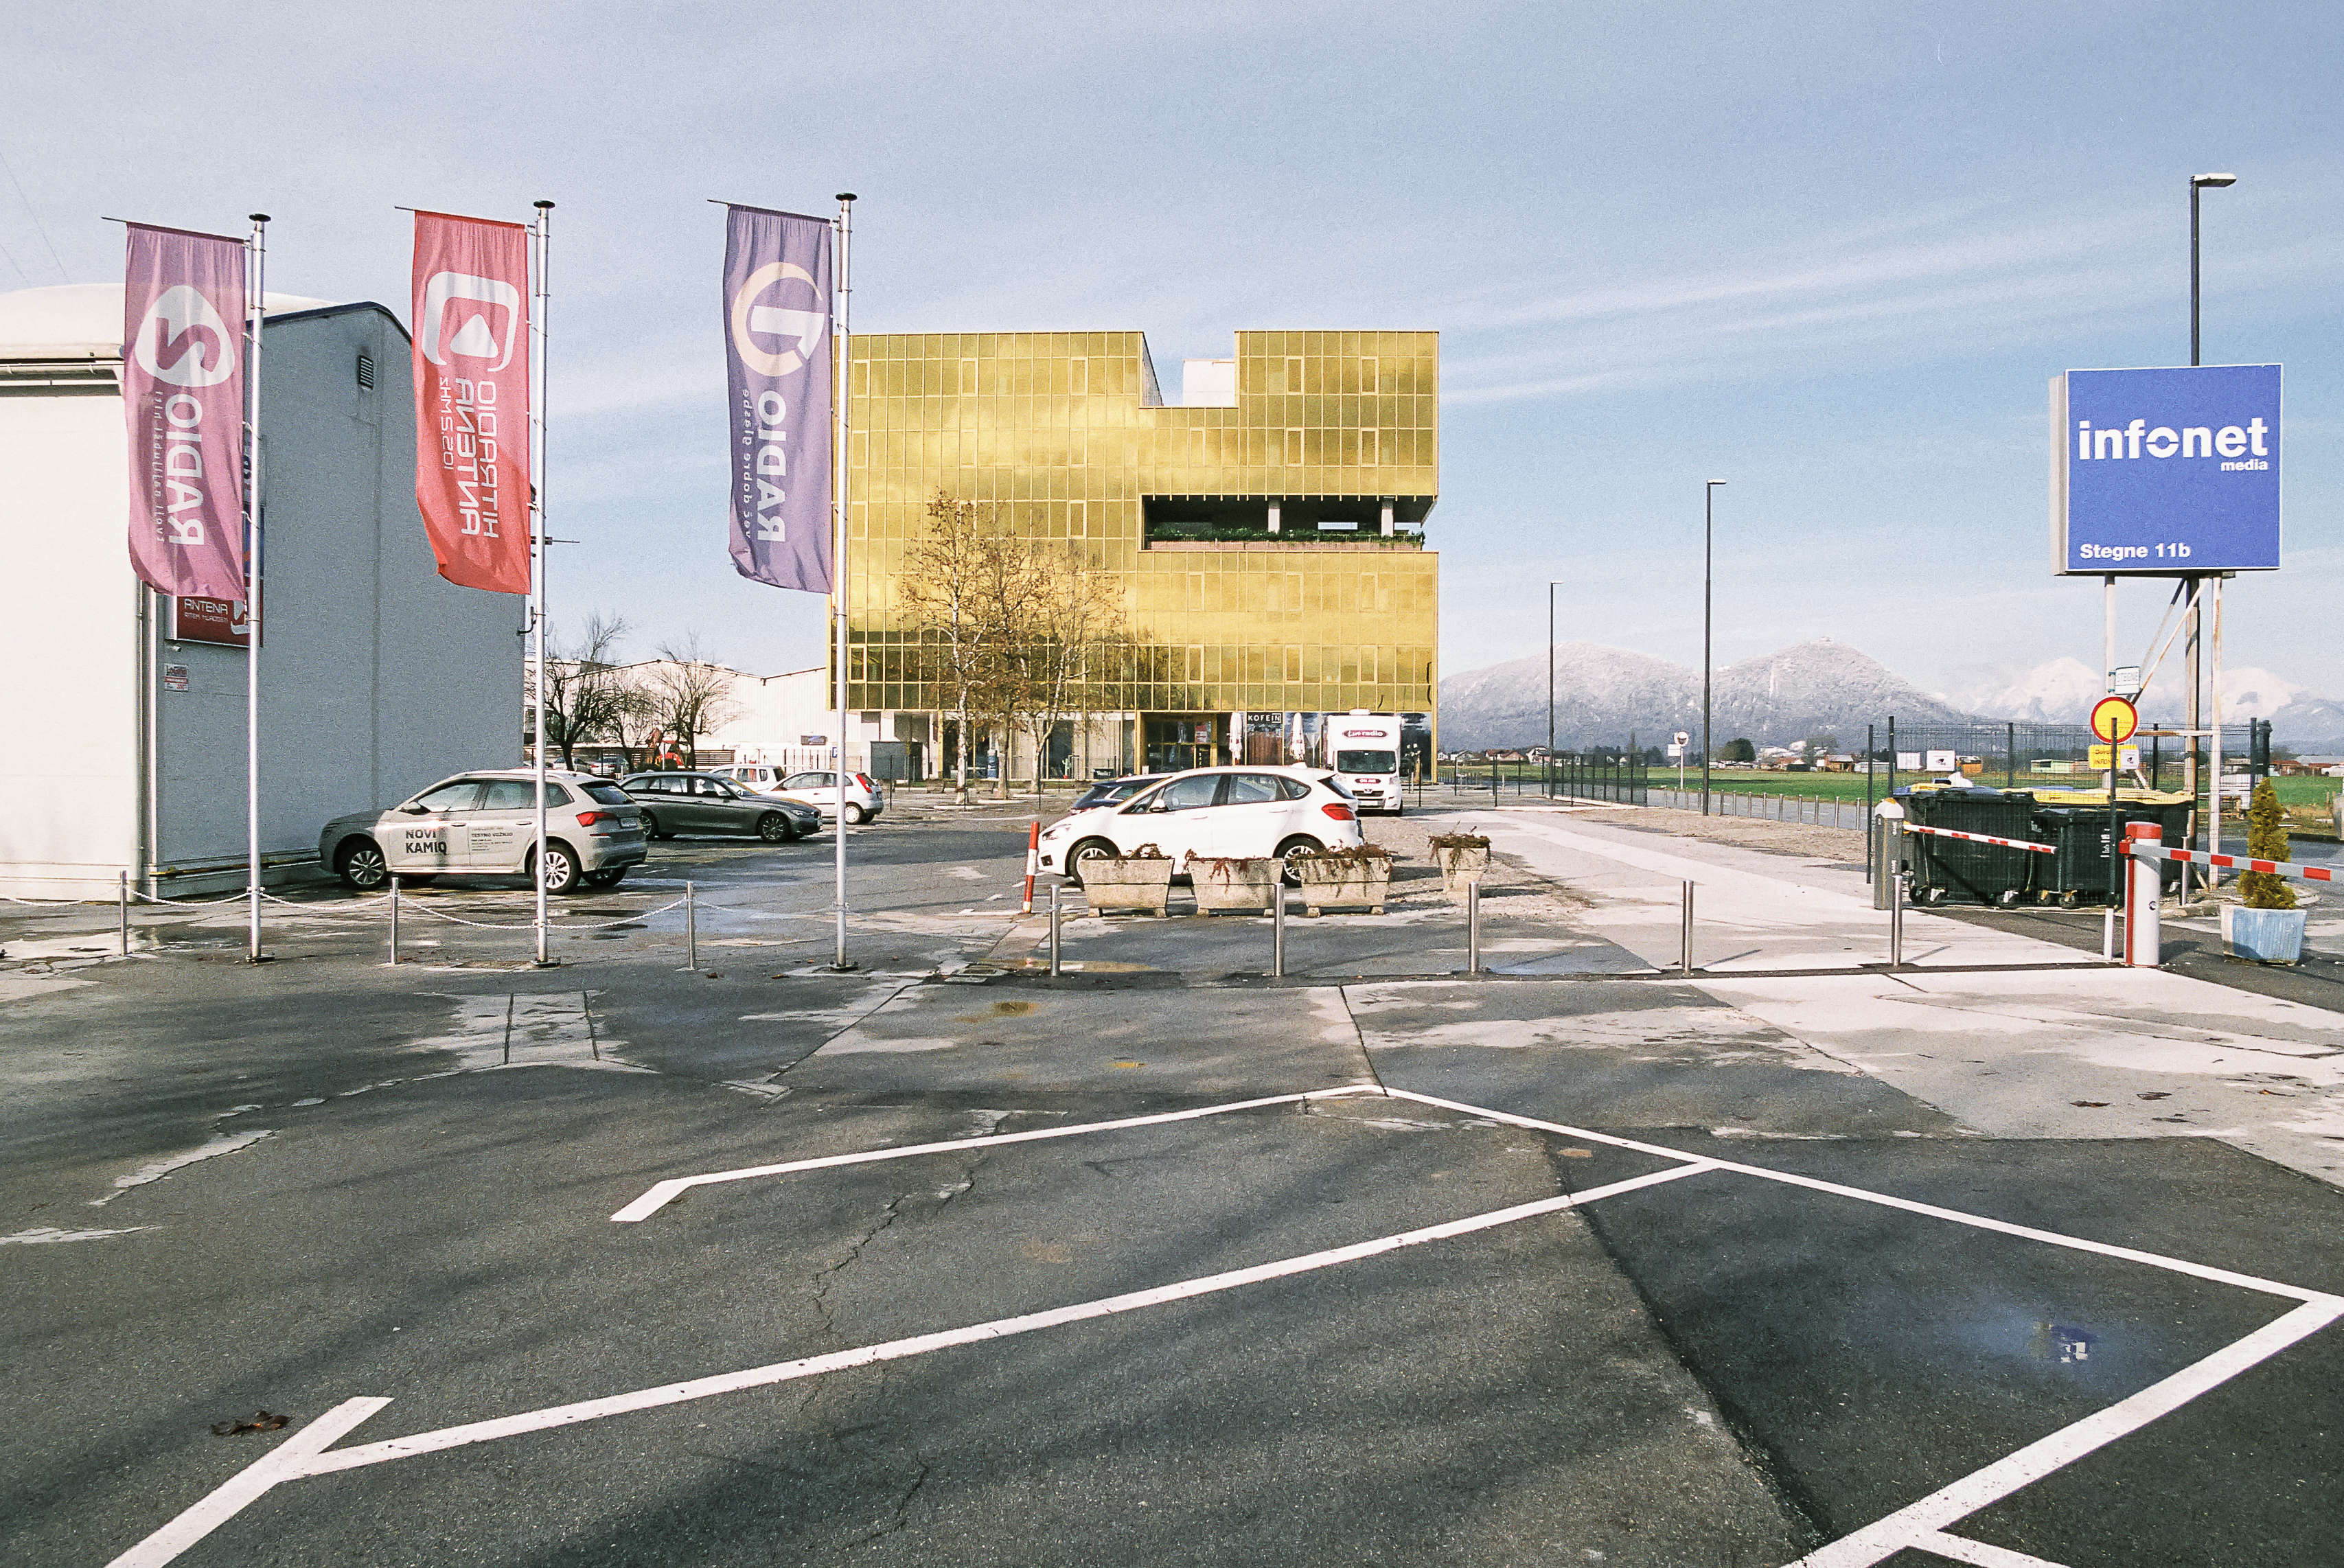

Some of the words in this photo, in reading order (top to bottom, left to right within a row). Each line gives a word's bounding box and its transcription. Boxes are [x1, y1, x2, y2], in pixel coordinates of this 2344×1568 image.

[2078, 417, 2268, 460] infonet
[2220, 459, 2268, 472] media
[2080, 543, 2148, 561] Stegne
[2155, 542, 2191, 557] 11b
[184, 598, 228, 615] ANTENA
[1248, 714, 1280, 722] KOFEIN
[405, 829, 437, 839] NOVI
[405, 841, 447, 855] KAMIQ
